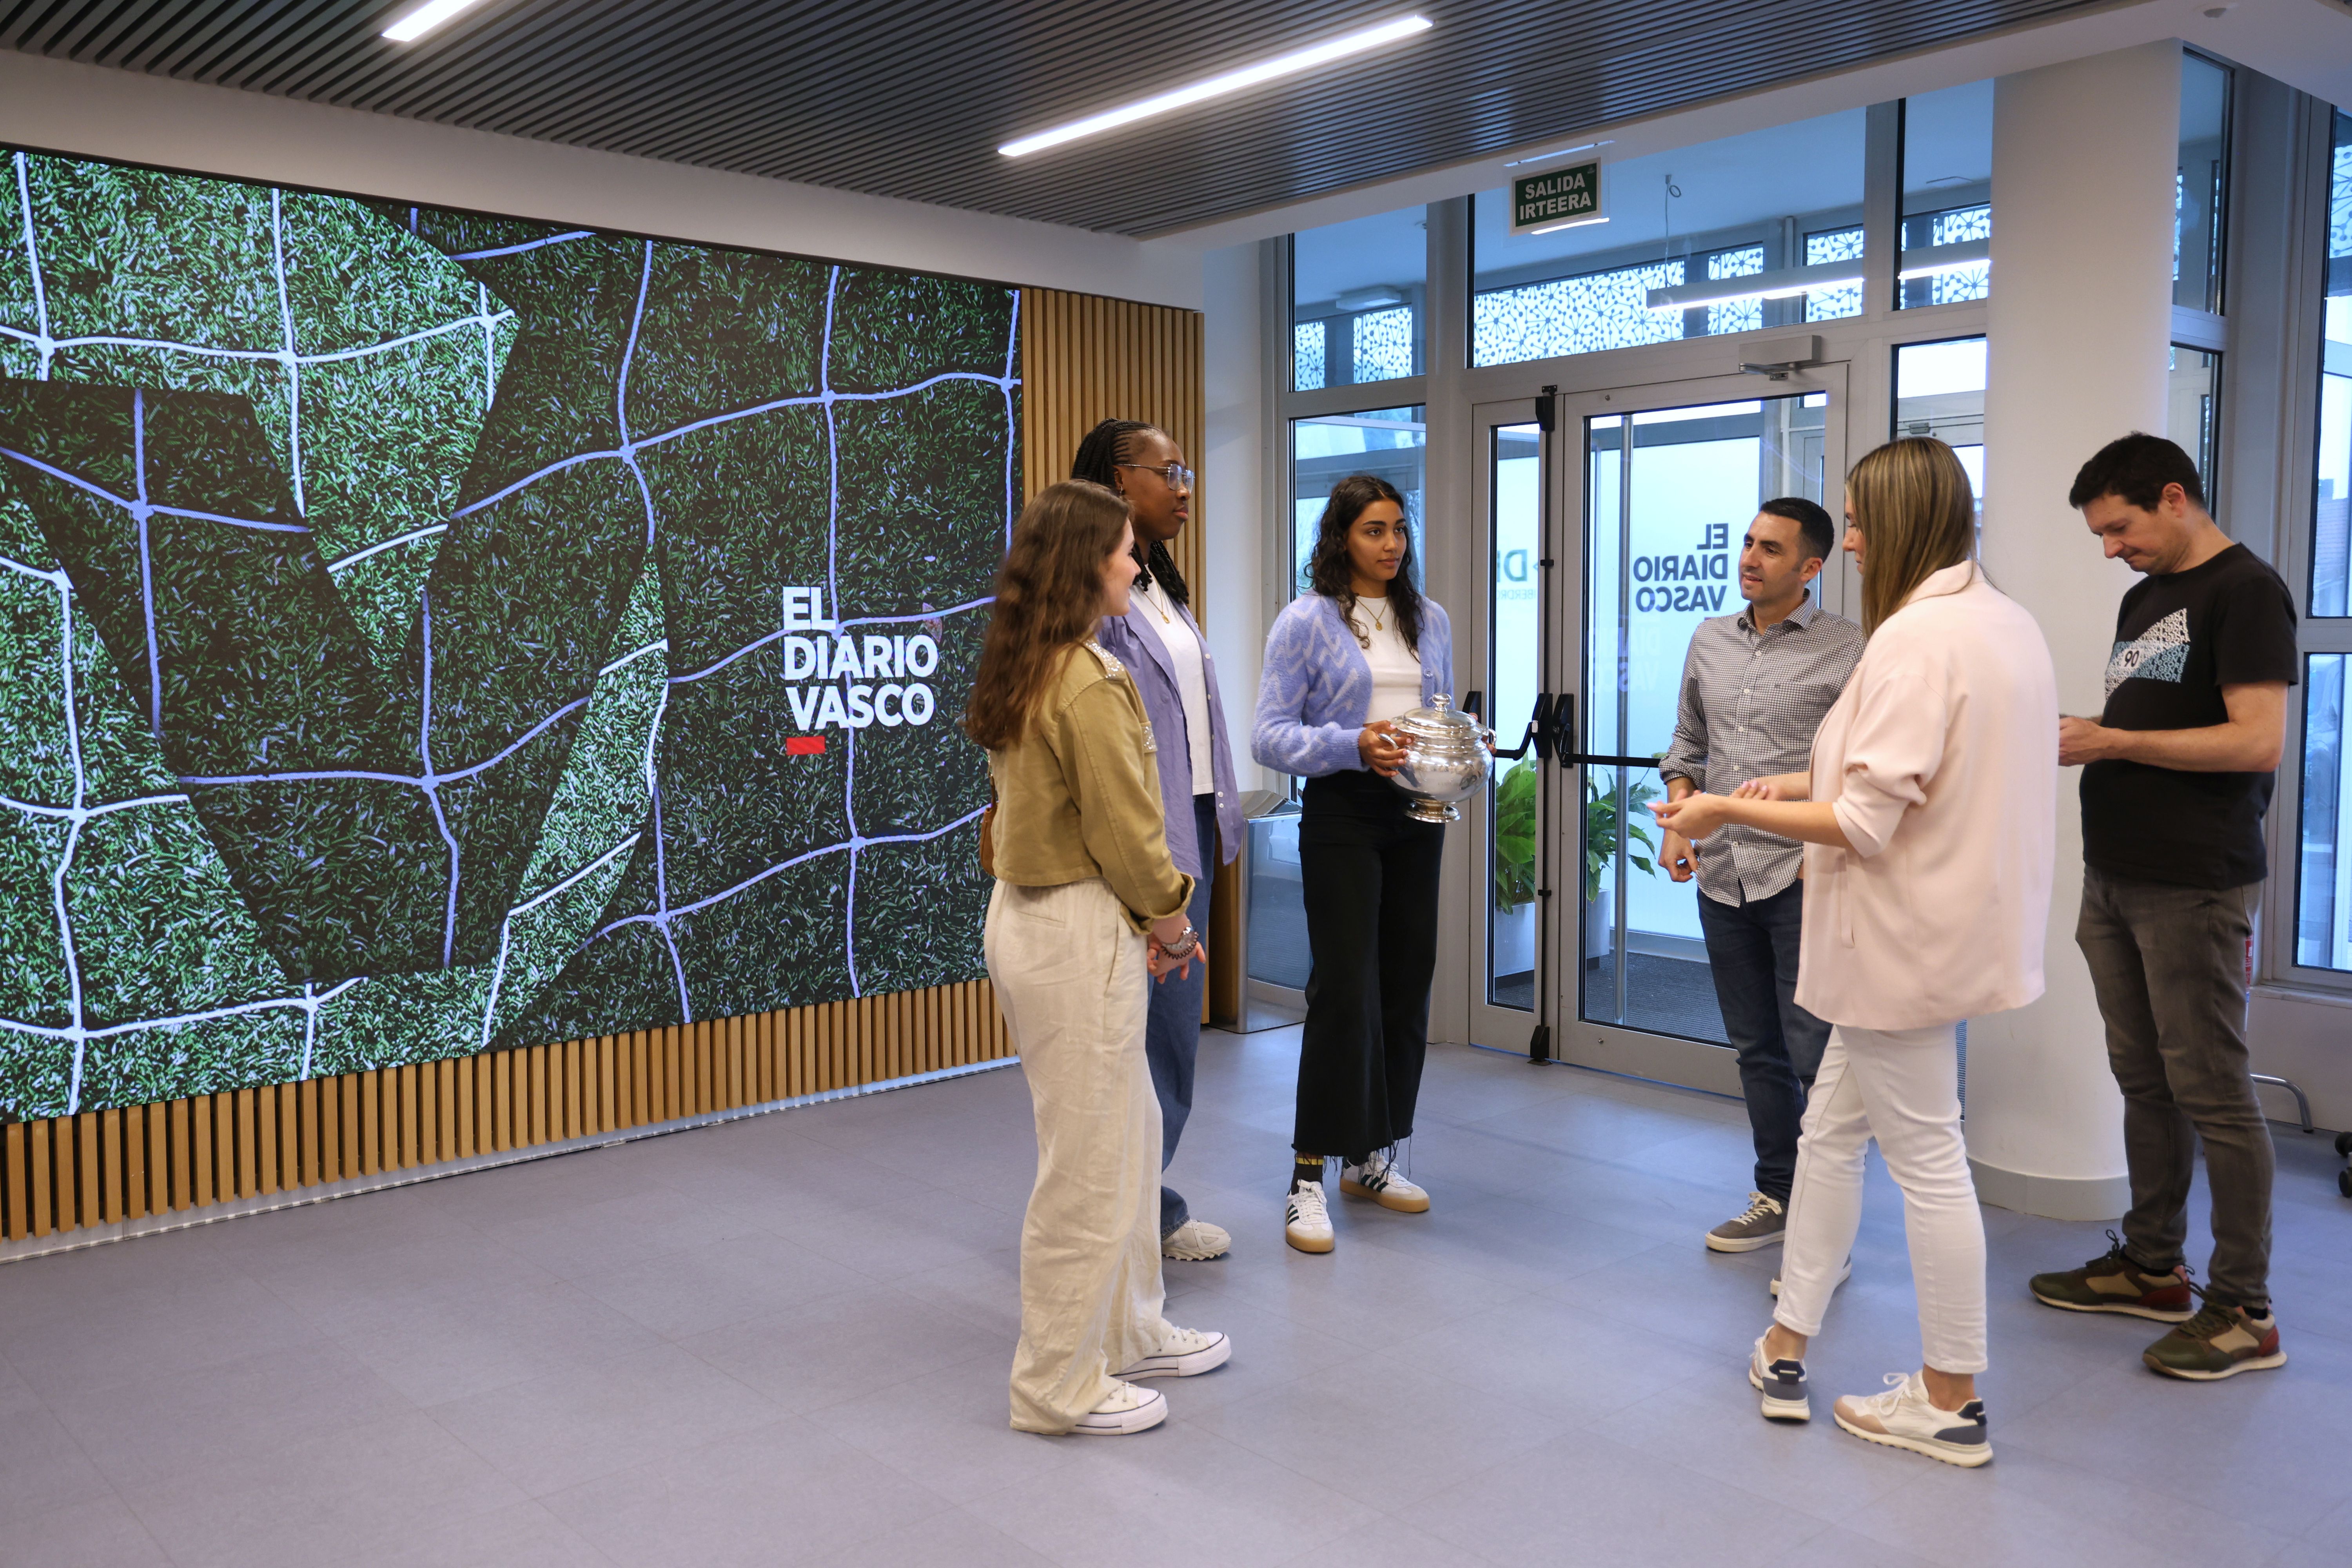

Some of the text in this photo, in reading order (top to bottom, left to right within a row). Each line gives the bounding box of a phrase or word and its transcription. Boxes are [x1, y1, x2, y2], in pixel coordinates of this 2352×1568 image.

[1525, 173, 1585, 199] SALIDA
[1520, 191, 1592, 220] IRTEERA
[783, 586, 836, 630] EL
[784, 635, 938, 680] DIARIO
[2124, 650, 2139, 667] 90
[785, 682, 935, 731] VASCO
